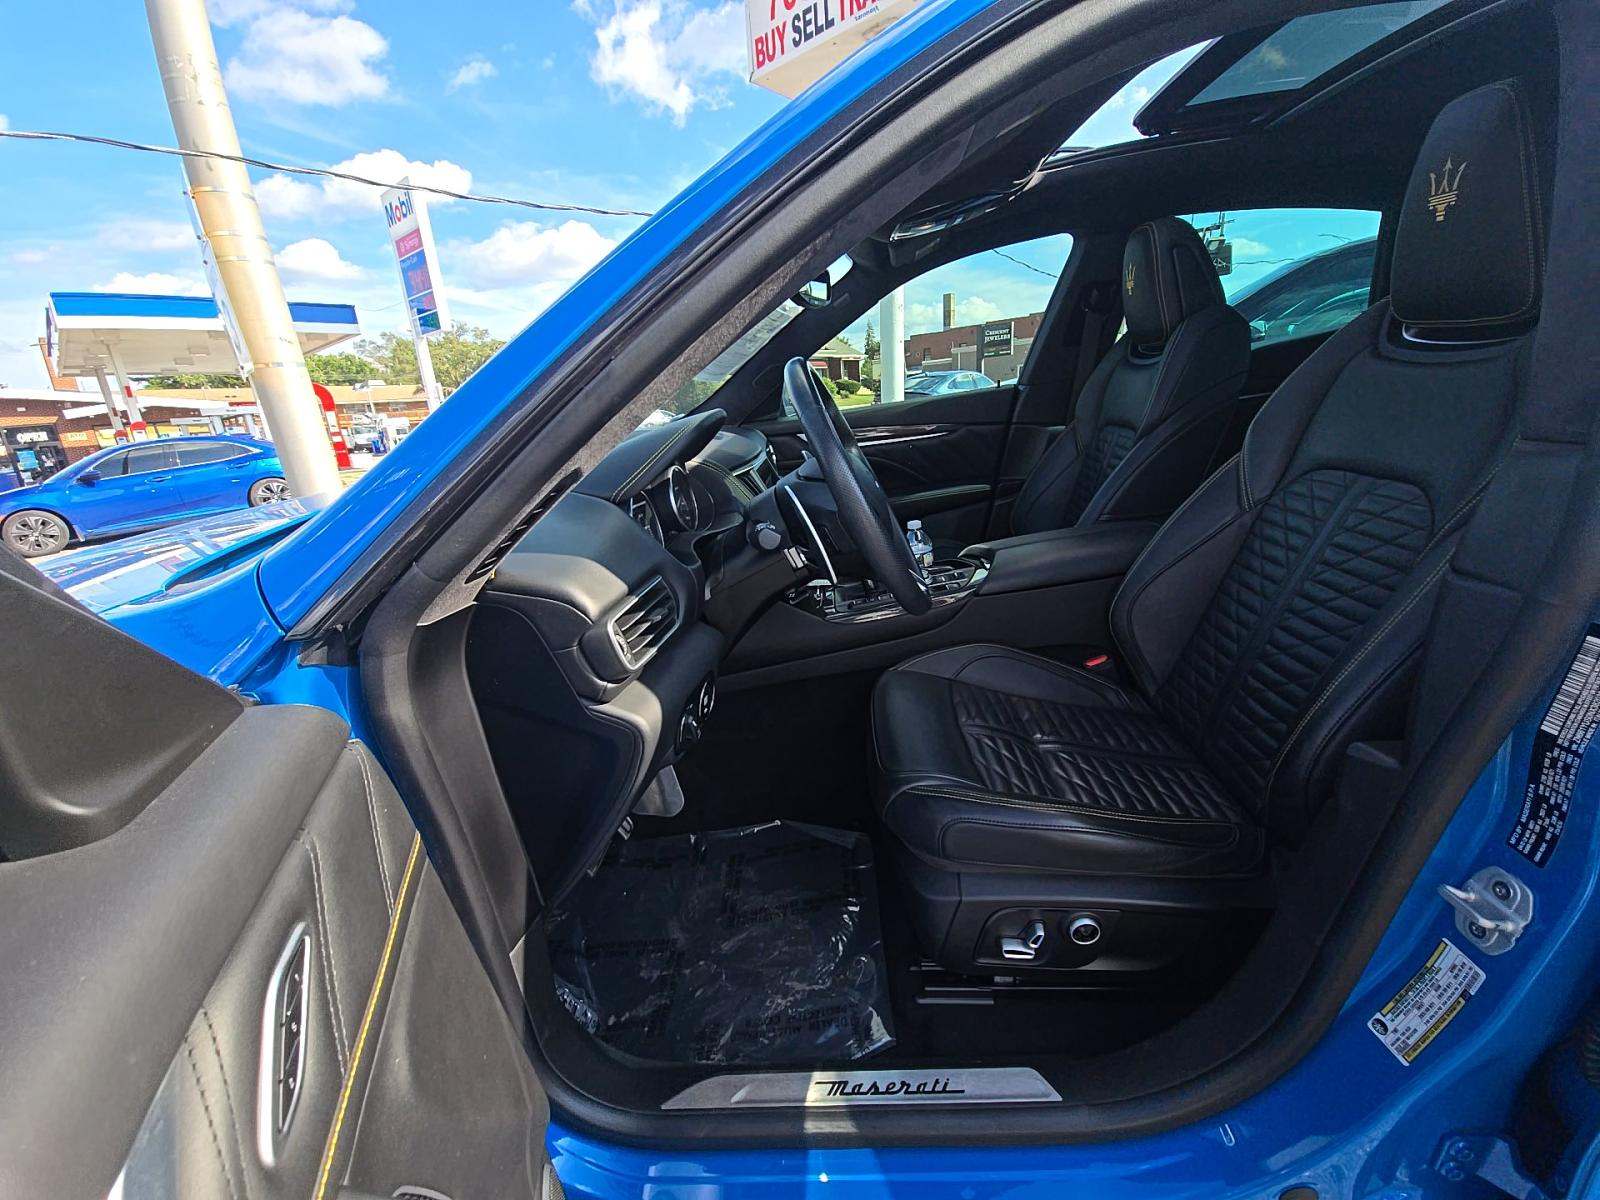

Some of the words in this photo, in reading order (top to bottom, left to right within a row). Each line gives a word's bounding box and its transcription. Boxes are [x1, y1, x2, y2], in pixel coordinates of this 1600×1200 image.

[754, 21, 787, 69] BUY
[791, 0, 835, 48] SELL
[384, 190, 414, 228] Mobil
[815, 1078, 965, 1096] Maserati
